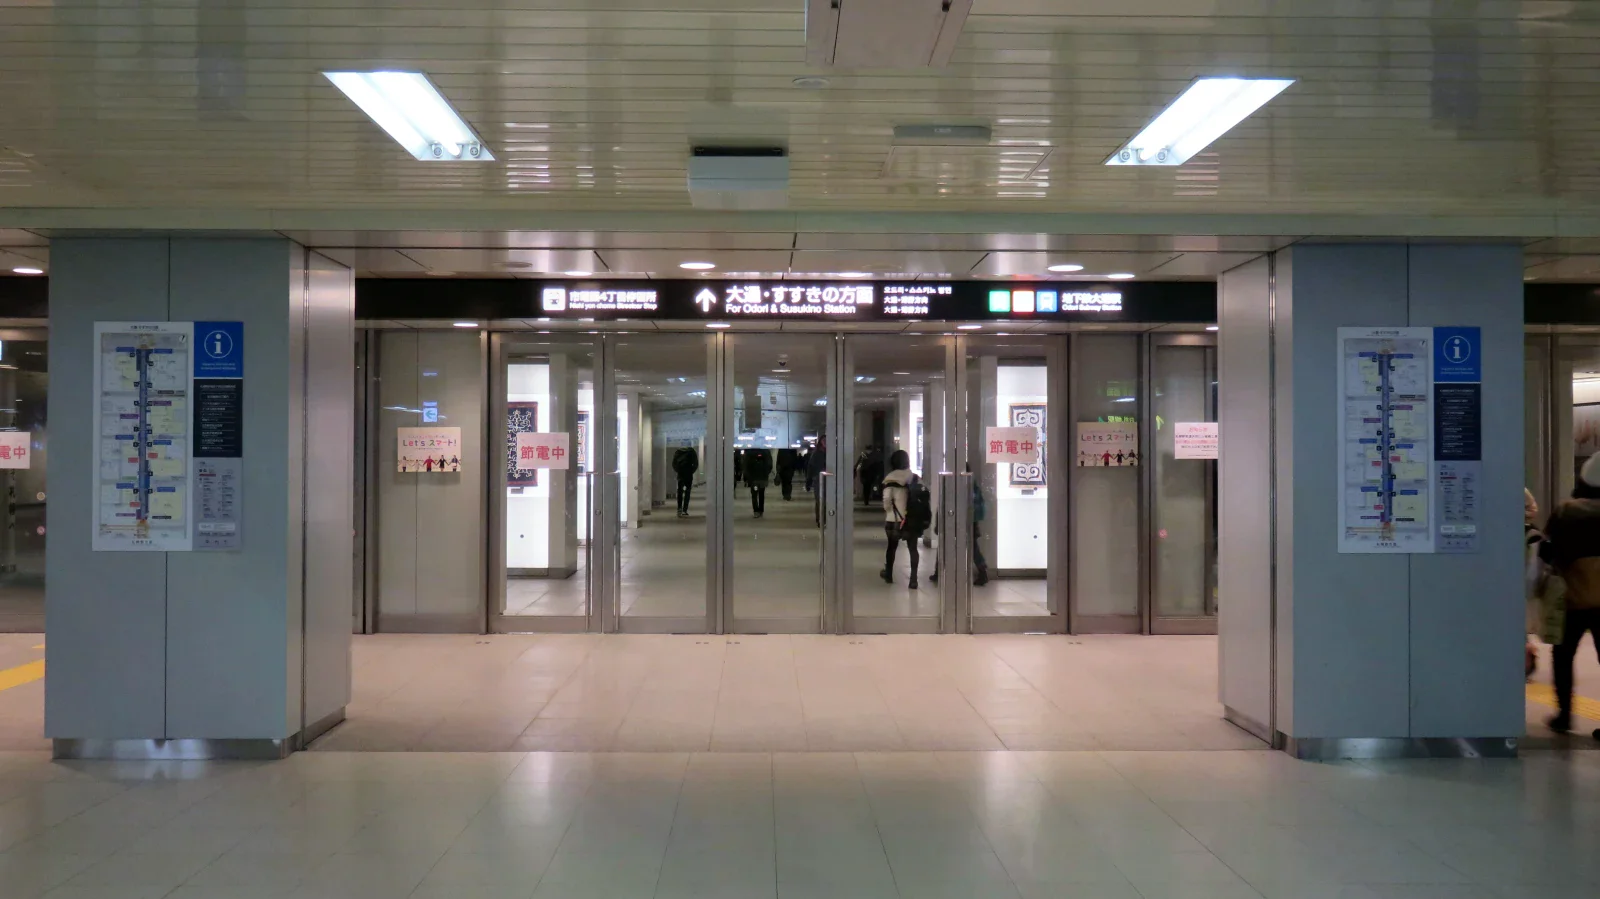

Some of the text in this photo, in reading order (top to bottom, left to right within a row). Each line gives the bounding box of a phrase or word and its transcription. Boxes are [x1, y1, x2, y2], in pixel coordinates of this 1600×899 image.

[726, 285, 873, 304] 大通・すすきの方面
[726, 304, 856, 313] For Odori & Susukino Station
[403, 439, 425, 447] Let's
[1081, 433, 1103, 442] Let's
[520, 445, 565, 460] 節電中
[989, 440, 1034, 455] 節電中
